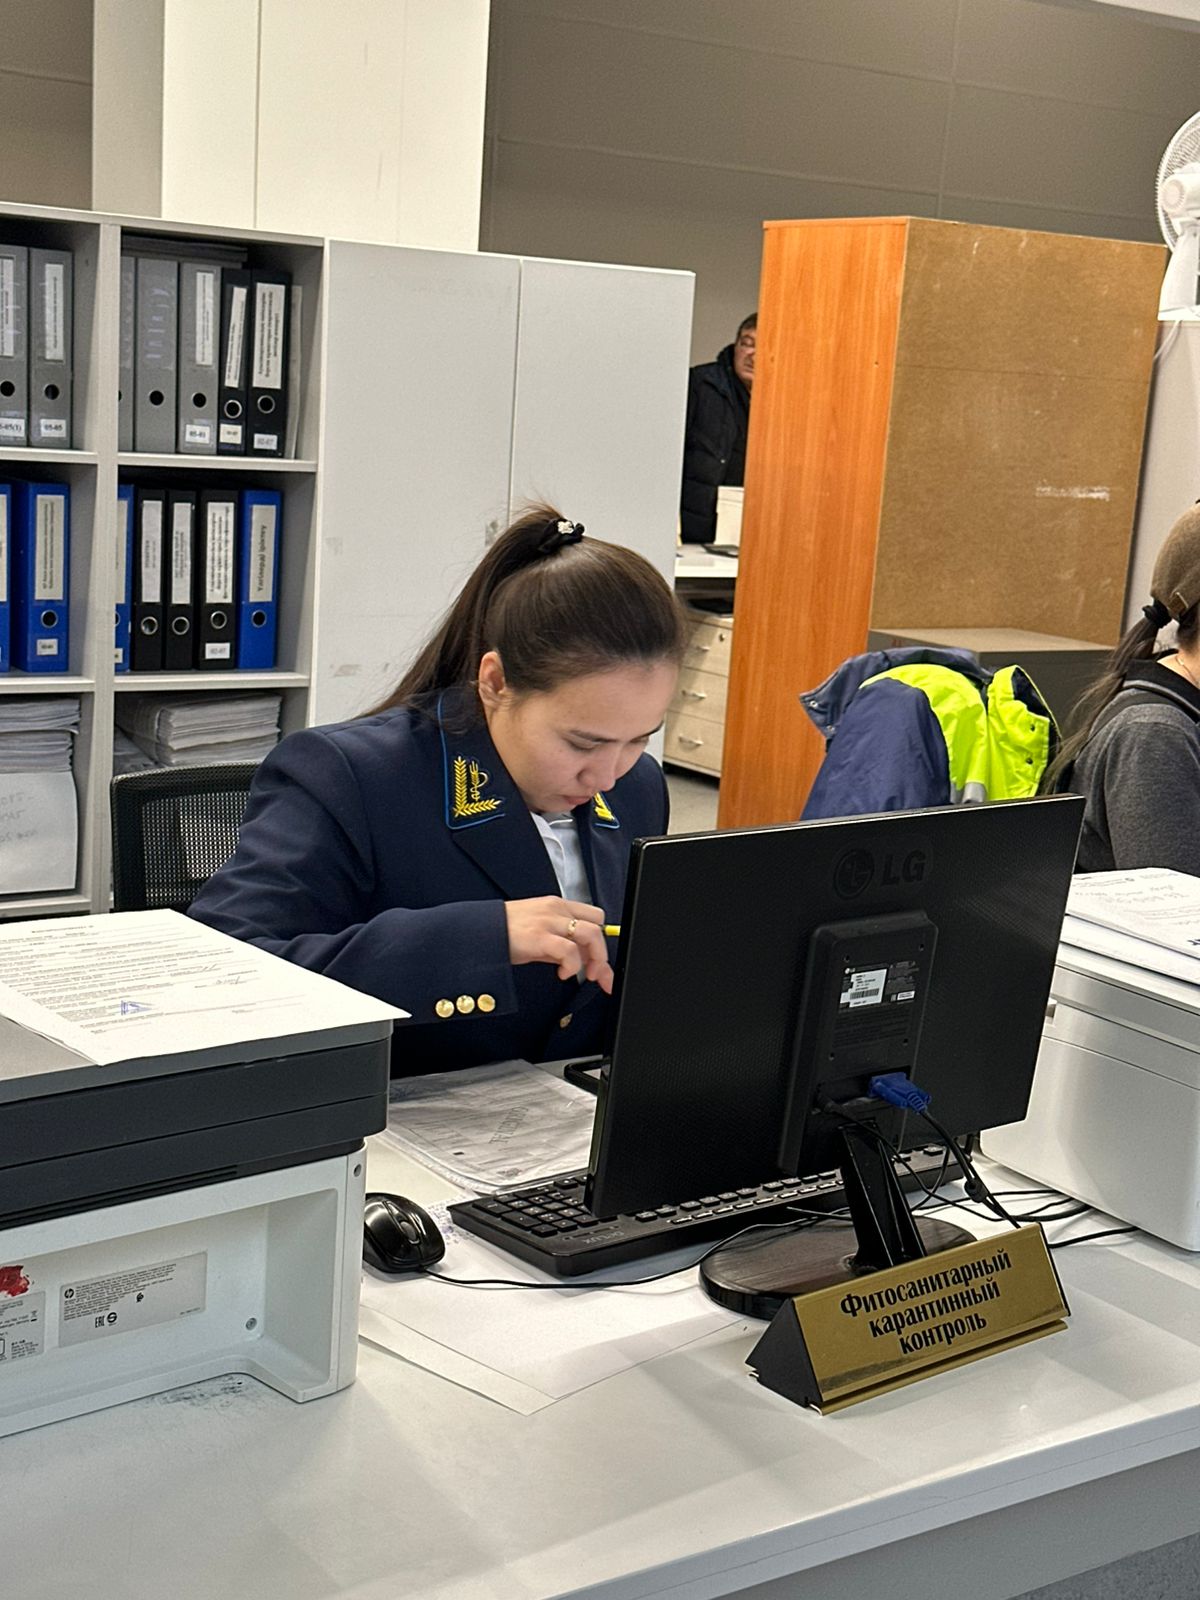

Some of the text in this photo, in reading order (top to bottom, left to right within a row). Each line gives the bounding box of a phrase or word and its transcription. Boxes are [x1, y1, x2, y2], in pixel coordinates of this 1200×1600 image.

[881, 850, 926, 886] LG
[840, 1248, 1012, 1318] Фитосанитарный
[869, 1277, 1001, 1338] карантинный
[899, 1312, 987, 1355] контроль
